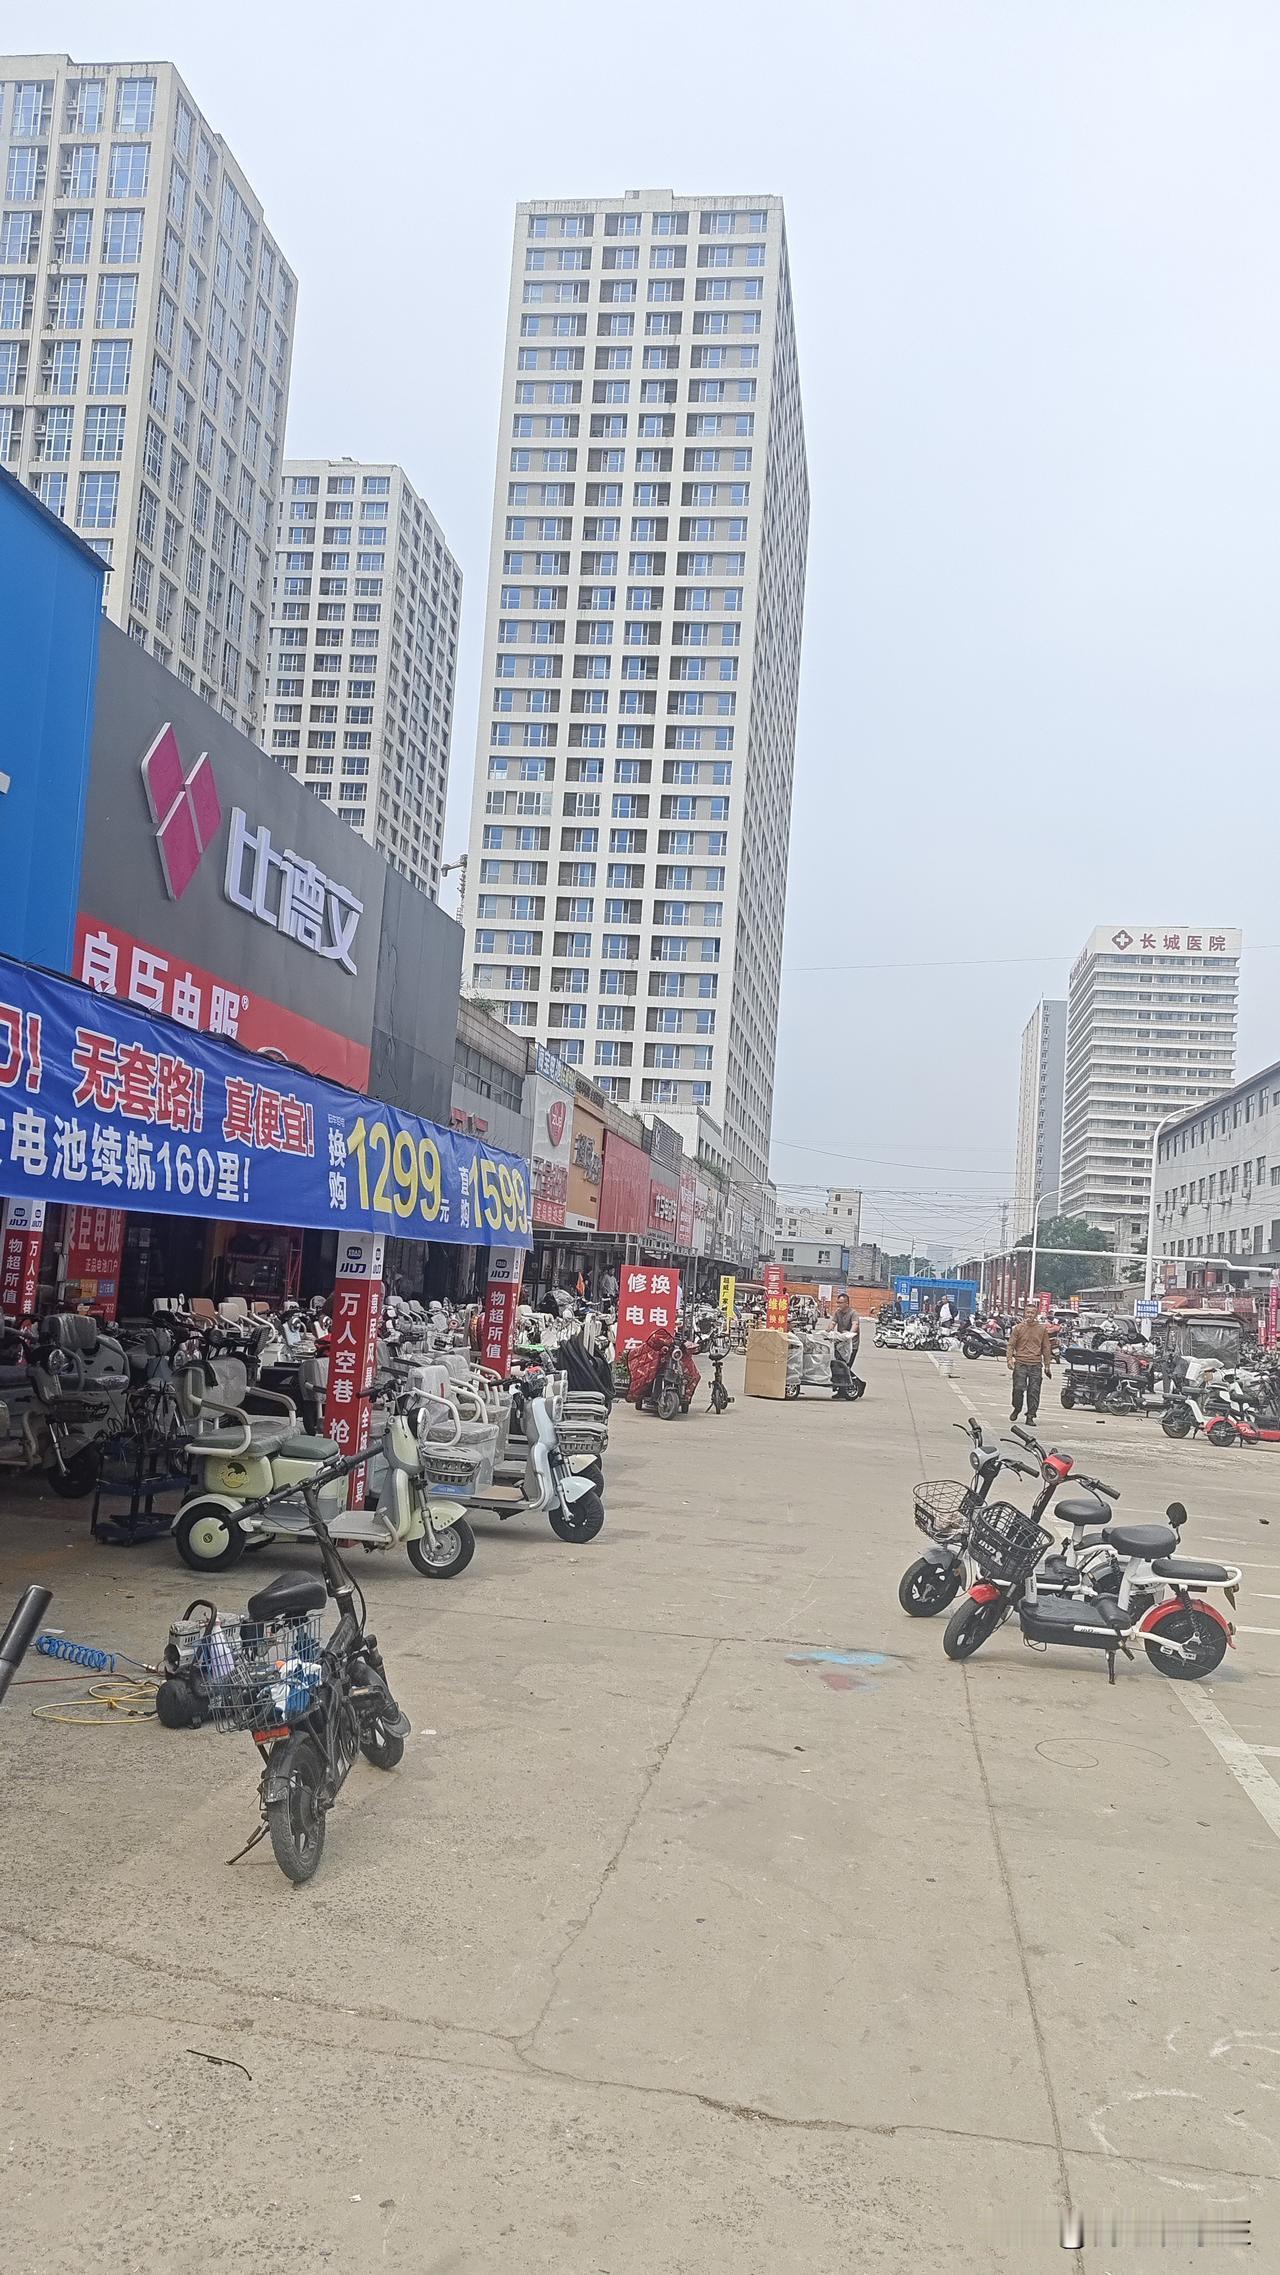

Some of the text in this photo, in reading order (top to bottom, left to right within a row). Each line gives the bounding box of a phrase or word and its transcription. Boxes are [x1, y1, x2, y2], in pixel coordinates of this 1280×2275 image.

[224, 806, 364, 976] 比德文
[1139, 933, 1226, 951] 长城医院
[71, 1026, 205, 1134] 无套路!
[222, 1076, 316, 1158] 真便宜!
[0, 1107, 250, 1202] 电池续航160里!
[3, 1238, 23, 1304] 物超所值
[22, 1240, 39, 1315] 万人空巷
[333, 1292, 361, 1404] 万人空巷
[482, 1291, 506, 1359] 物超所值
